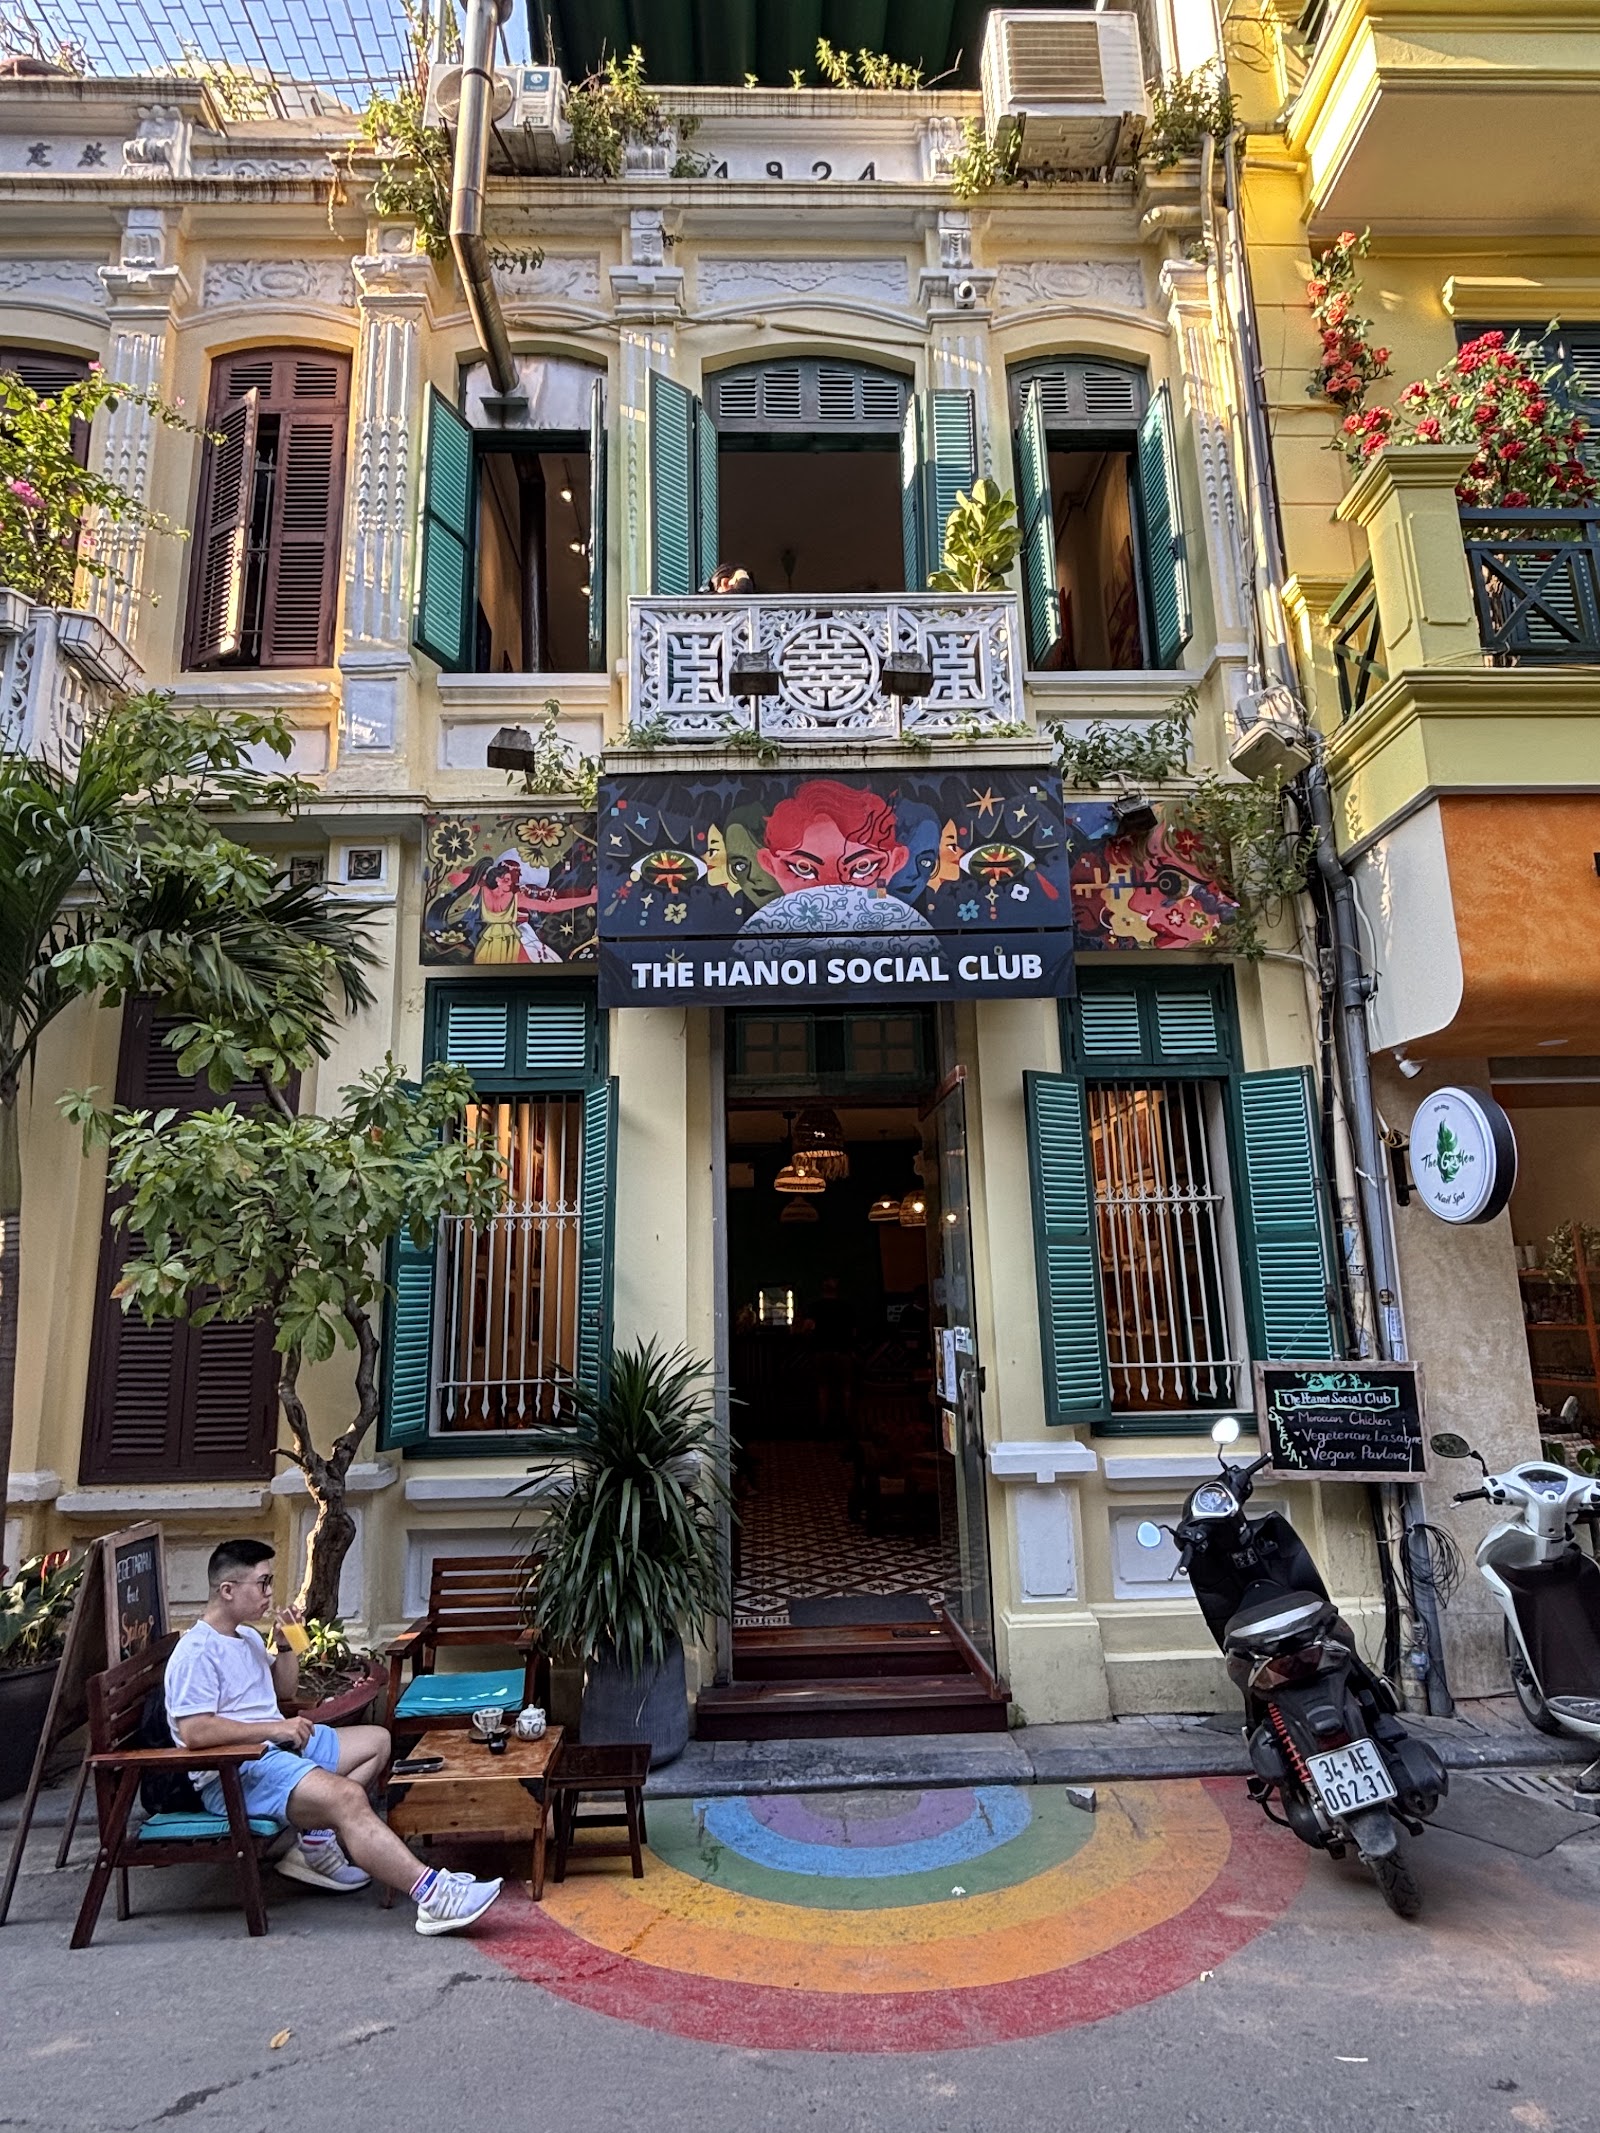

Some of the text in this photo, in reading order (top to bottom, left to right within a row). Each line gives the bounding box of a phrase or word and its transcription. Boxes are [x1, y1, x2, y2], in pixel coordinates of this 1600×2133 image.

[632, 954, 1043, 988] THE HANOI SOCIAL CLUB
[1421, 1154, 1437, 1171] The
[1434, 1191, 1465, 1206] Nail Spa
[1281, 1391, 1391, 1406] The Hanoi Social Club
[1349, 1411, 1392, 1426] Chicken
[1268, 1407, 1308, 1469] SPECIAL
[1309, 1444, 1410, 1467] Vegan Pavlova
[1324, 1770, 1391, 1811] 062.31
